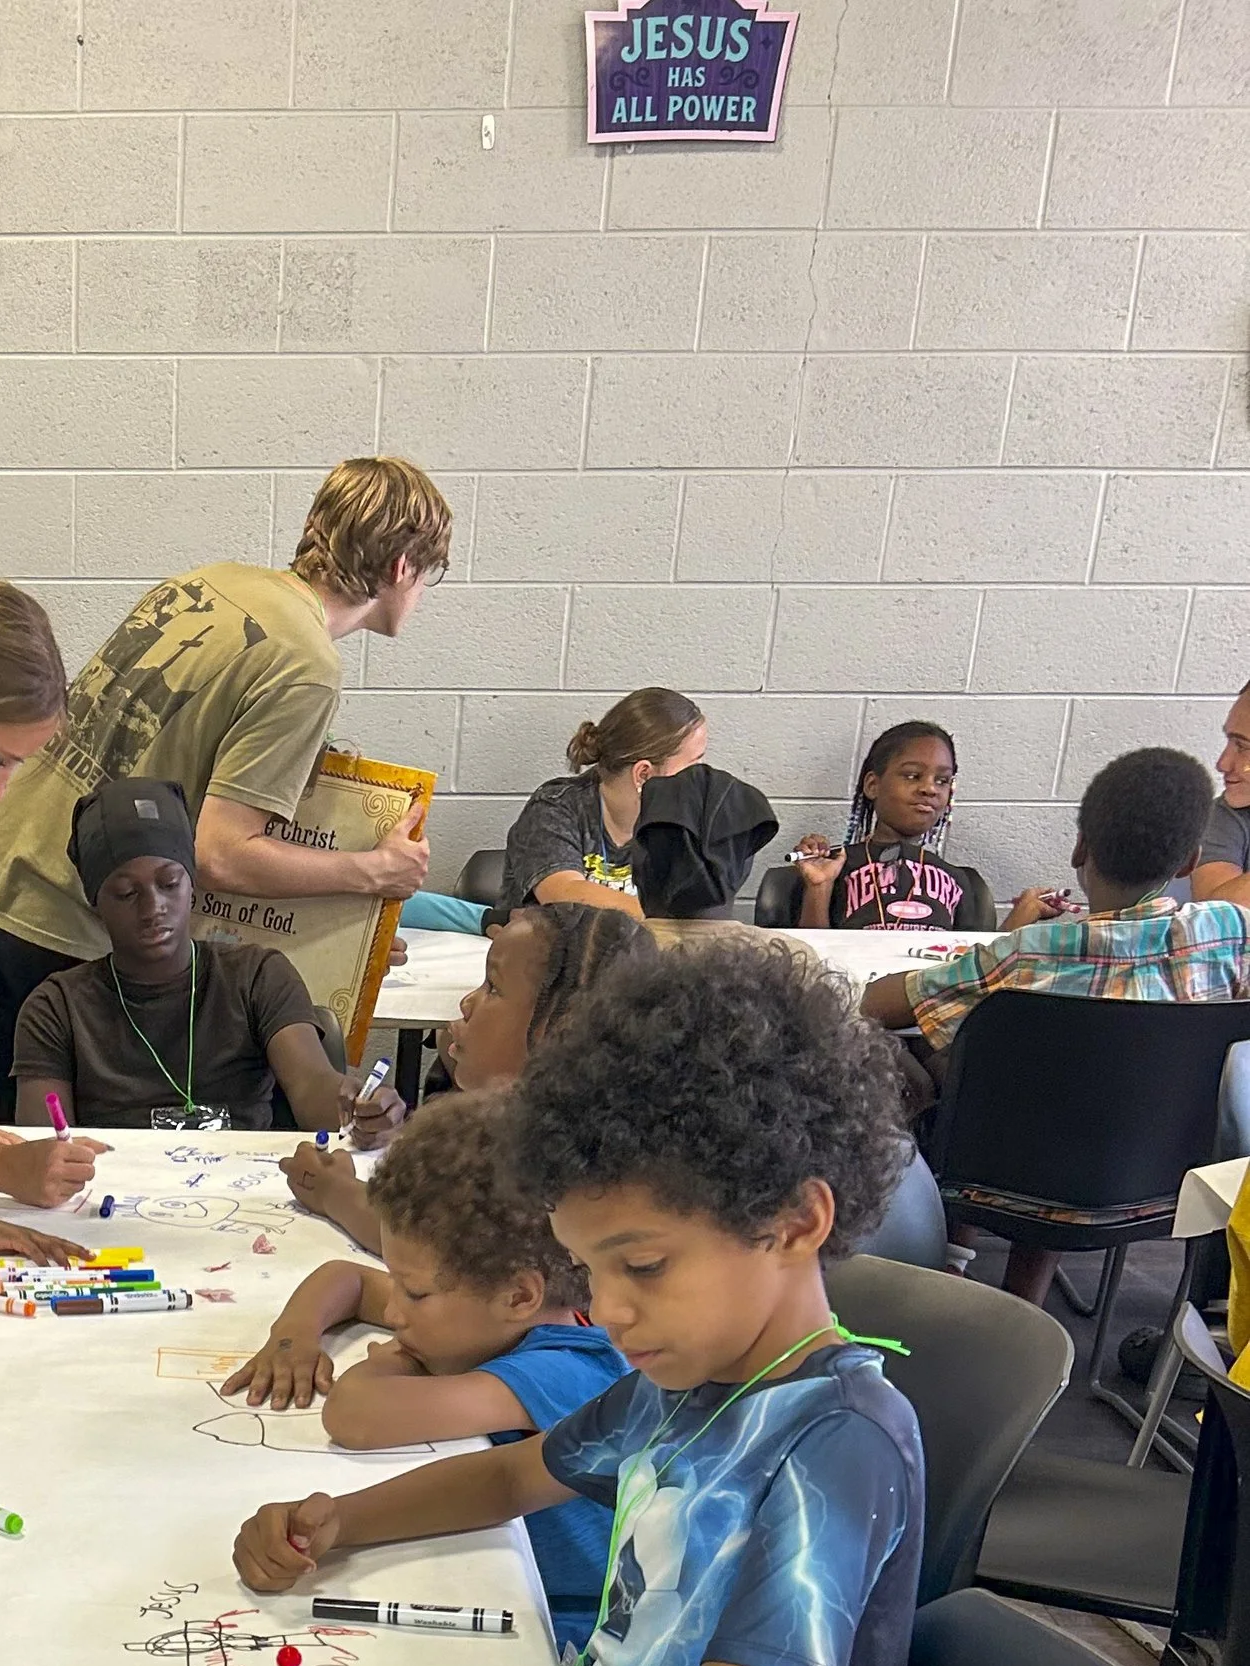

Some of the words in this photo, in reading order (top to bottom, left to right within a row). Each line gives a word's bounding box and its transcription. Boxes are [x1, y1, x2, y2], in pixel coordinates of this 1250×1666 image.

[621, 14, 752, 63] JESUS
[667, 67, 706, 88] HAS
[611, 96, 658, 124] ALL
[667, 95, 758, 123] POWER
[281, 821, 339, 851] Christ.
[844, 859, 902, 918] NEW
[905, 859, 964, 926] YORK
[202, 893, 231, 919] Son
[238, 903, 258, 924] of
[262, 907, 297, 935] God.
[413, 1618, 457, 1627] Washable
